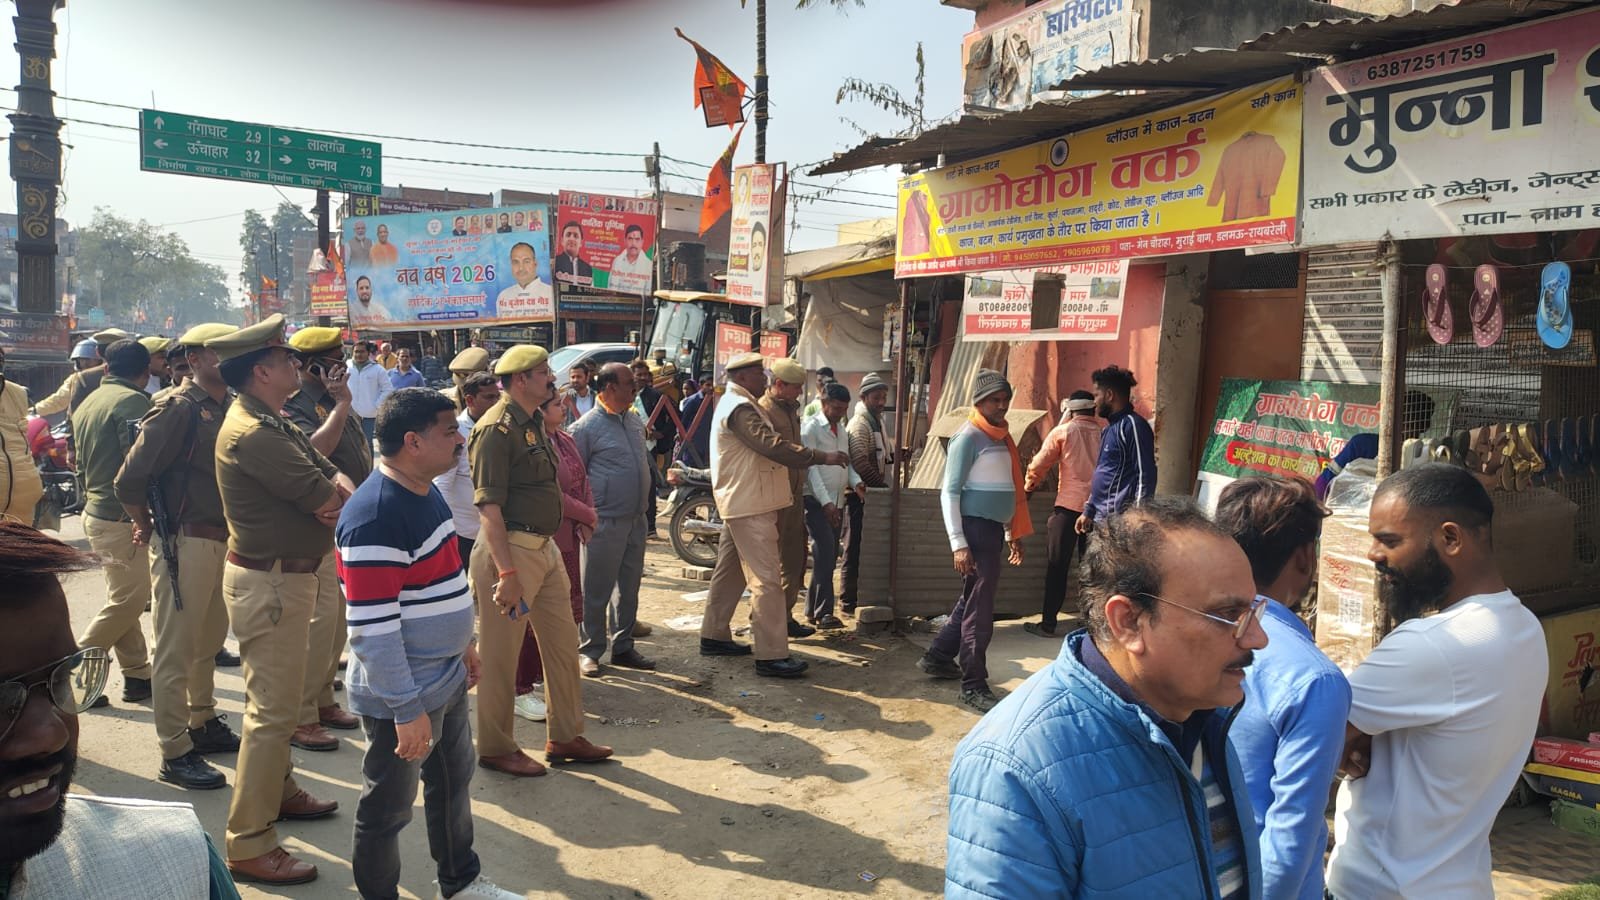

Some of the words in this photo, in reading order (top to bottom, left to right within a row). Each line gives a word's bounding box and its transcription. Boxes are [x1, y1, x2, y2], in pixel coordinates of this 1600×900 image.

[1367, 42, 1486, 81] 6387251759
[1274, 88, 1296, 102] काम
[1326, 53, 1554, 174] मुन्ना
[187, 120, 228, 138] गंगाघाट
[246, 130, 262, 144] 2.9
[1142, 120, 1152, 134] में
[246, 150, 260, 164] 32
[306, 138, 345, 154] लालगंज
[360, 147, 372, 160] 12
[308, 158, 337, 173] उन्नाव
[360, 166, 372, 178] 79
[939, 162, 1098, 224] ग्रामोद्योग
[1110, 128, 1207, 190] वर्क
[1186, 184, 1204, 198] आदि
[1309, 192, 1347, 210] सभी
[1352, 188, 1408, 208] प्रकार
[1412, 184, 1436, 200] के
[1443, 178, 1520, 198] लेडीज,
[998, 228, 1014, 244] कार्य
[1016, 228, 1044, 245] प्रमुखता
[1047, 223, 1055, 237] के
[1058, 220, 1072, 237] तौर
[1075, 223, 1087, 234] पर
[1090, 216, 1112, 232] किया
[1116, 215, 1138, 229] जाता
[1142, 209, 1150, 227] है
[1176, 230, 1195, 250] मुराई
[1216, 220, 1288, 242] डलमऊ-रायबरेली
[1064, 245, 1112, 258] 7905969078
[396, 266, 420, 288] नव
[424, 254, 453, 289] वर्ष
[451, 264, 496, 284] 2026
[1256, 390, 1338, 424] ग्रामोद्योग
[1214, 418, 1237, 436] हमारे
[1256, 425, 1276, 441] काज
[1267, 453, 1281, 466] का
[1282, 456, 1302, 471] कार्य
[1570, 756, 1600, 766] FASHIO
[1551, 785, 1584, 800] MAGMA
